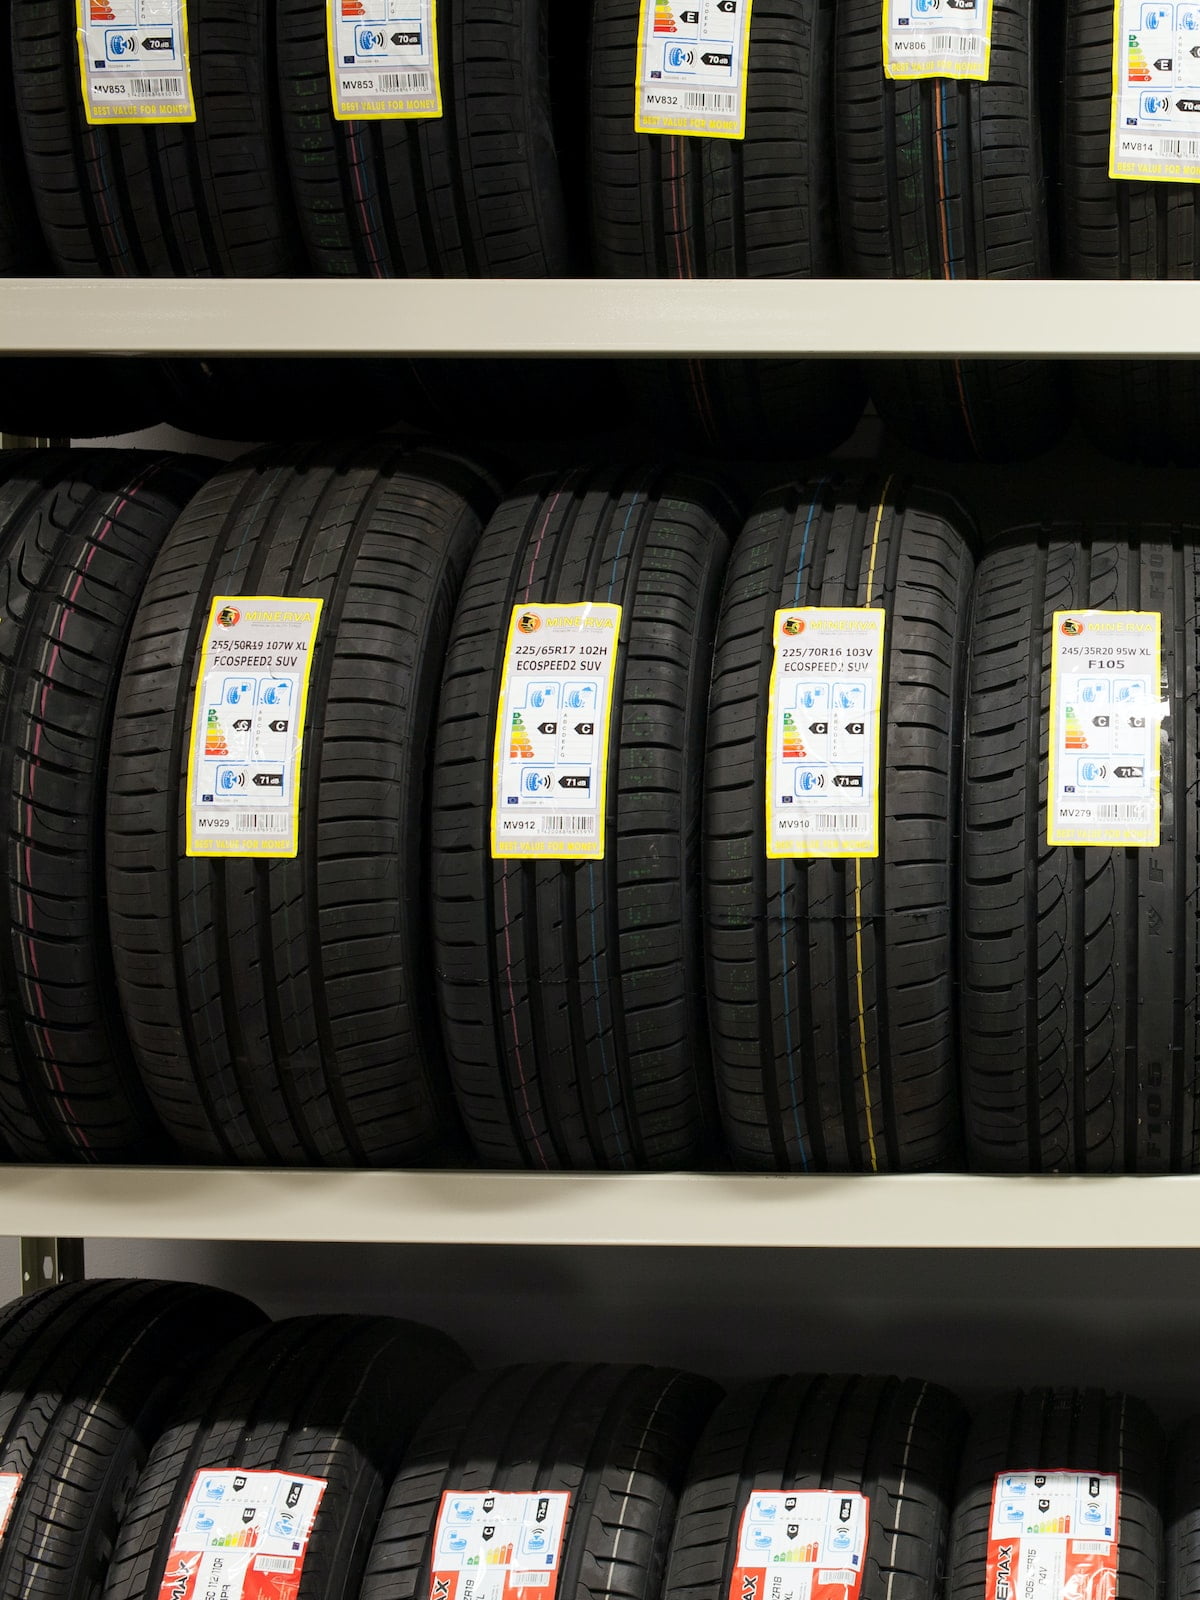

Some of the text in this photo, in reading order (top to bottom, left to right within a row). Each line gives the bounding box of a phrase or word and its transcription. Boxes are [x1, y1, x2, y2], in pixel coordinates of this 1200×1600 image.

[724, 2, 734, 12] C
[686, 12, 696, 23] E
[894, 41, 926, 50] MV806
[1160, 59, 1169, 70] E
[342, 80, 374, 89] MV853
[646, 95, 678, 105] MV832
[93, 104, 188, 116] BEST VALUE FOR MONEY
[341, 100, 435, 112] BEST VALUE FOR MONEY
[1122, 141, 1153, 151] MV814
[244, 611, 312, 622] MINERVA
[545, 616, 614, 628] MINERVA
[211, 640, 308, 651] 255/50R19 107W XL
[515, 646, 608, 656] 225/65R17 102H
[782, 648, 873, 657] 225/70R16 103V
[1061, 646, 1151, 656] 245/35R20 95W XL
[275, 656, 298, 667] SUV
[516, 660, 602, 672] ECOSPEED2 SUV
[1088, 660, 1125, 669] F105
[847, 662, 869, 672] SUV
[276, 721, 285, 731] C
[1099, 717, 1107, 727] C
[1134, 717, 1142, 727] C
[545, 723, 553, 734] C
[581, 723, 590, 734] C
[816, 723, 825, 734] C
[852, 723, 861, 734] C
[1060, 809, 1092, 818] MV279
[198, 818, 230, 828] MV929
[503, 820, 536, 830] MV912
[778, 820, 810, 829] MV910
